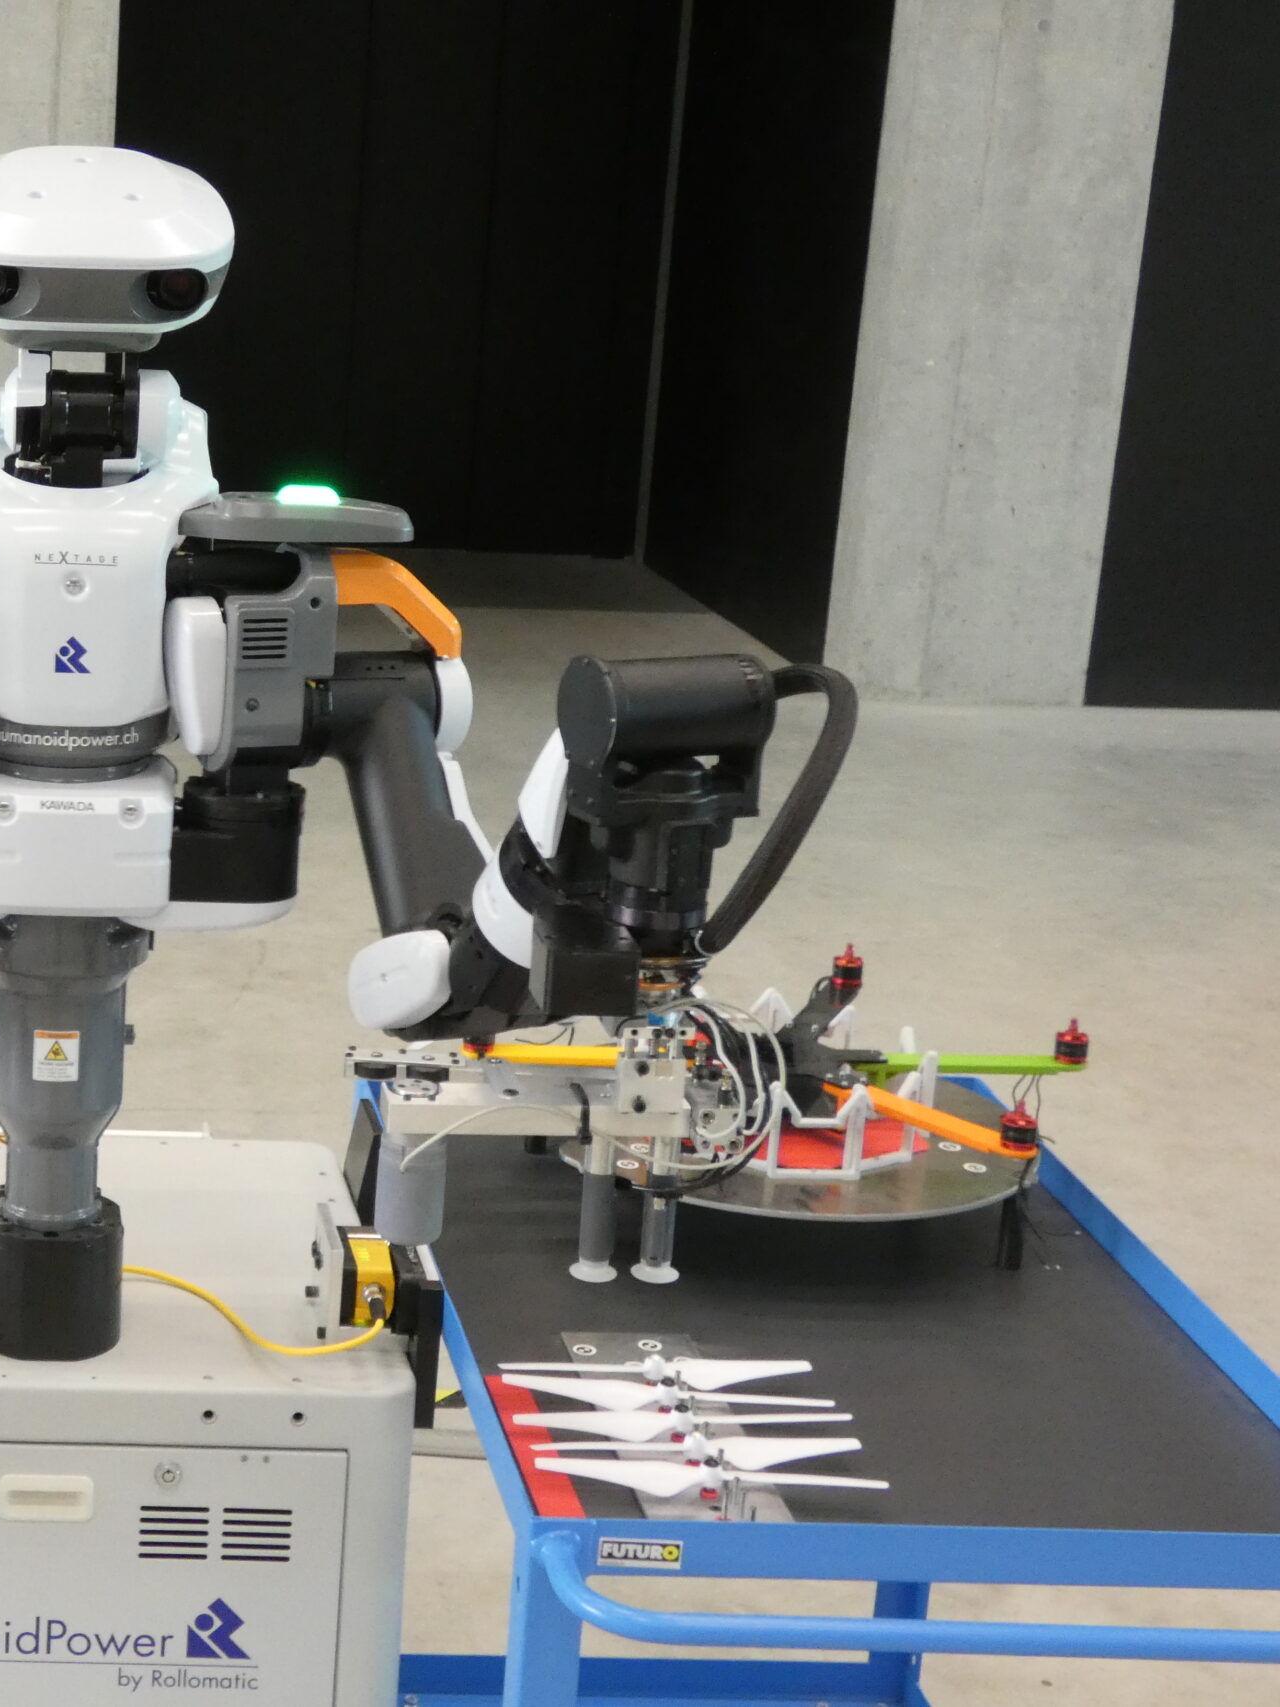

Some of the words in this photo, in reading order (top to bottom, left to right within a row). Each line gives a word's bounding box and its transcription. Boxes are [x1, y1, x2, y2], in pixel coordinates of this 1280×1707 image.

[34, 551, 119, 565] NEXTAGE
[39, 800, 96, 812] KAWADA
[601, 1542, 680, 1561] FUTURO
[117, 1667, 144, 1690] by
[151, 1669, 260, 1691] Rollomatic
